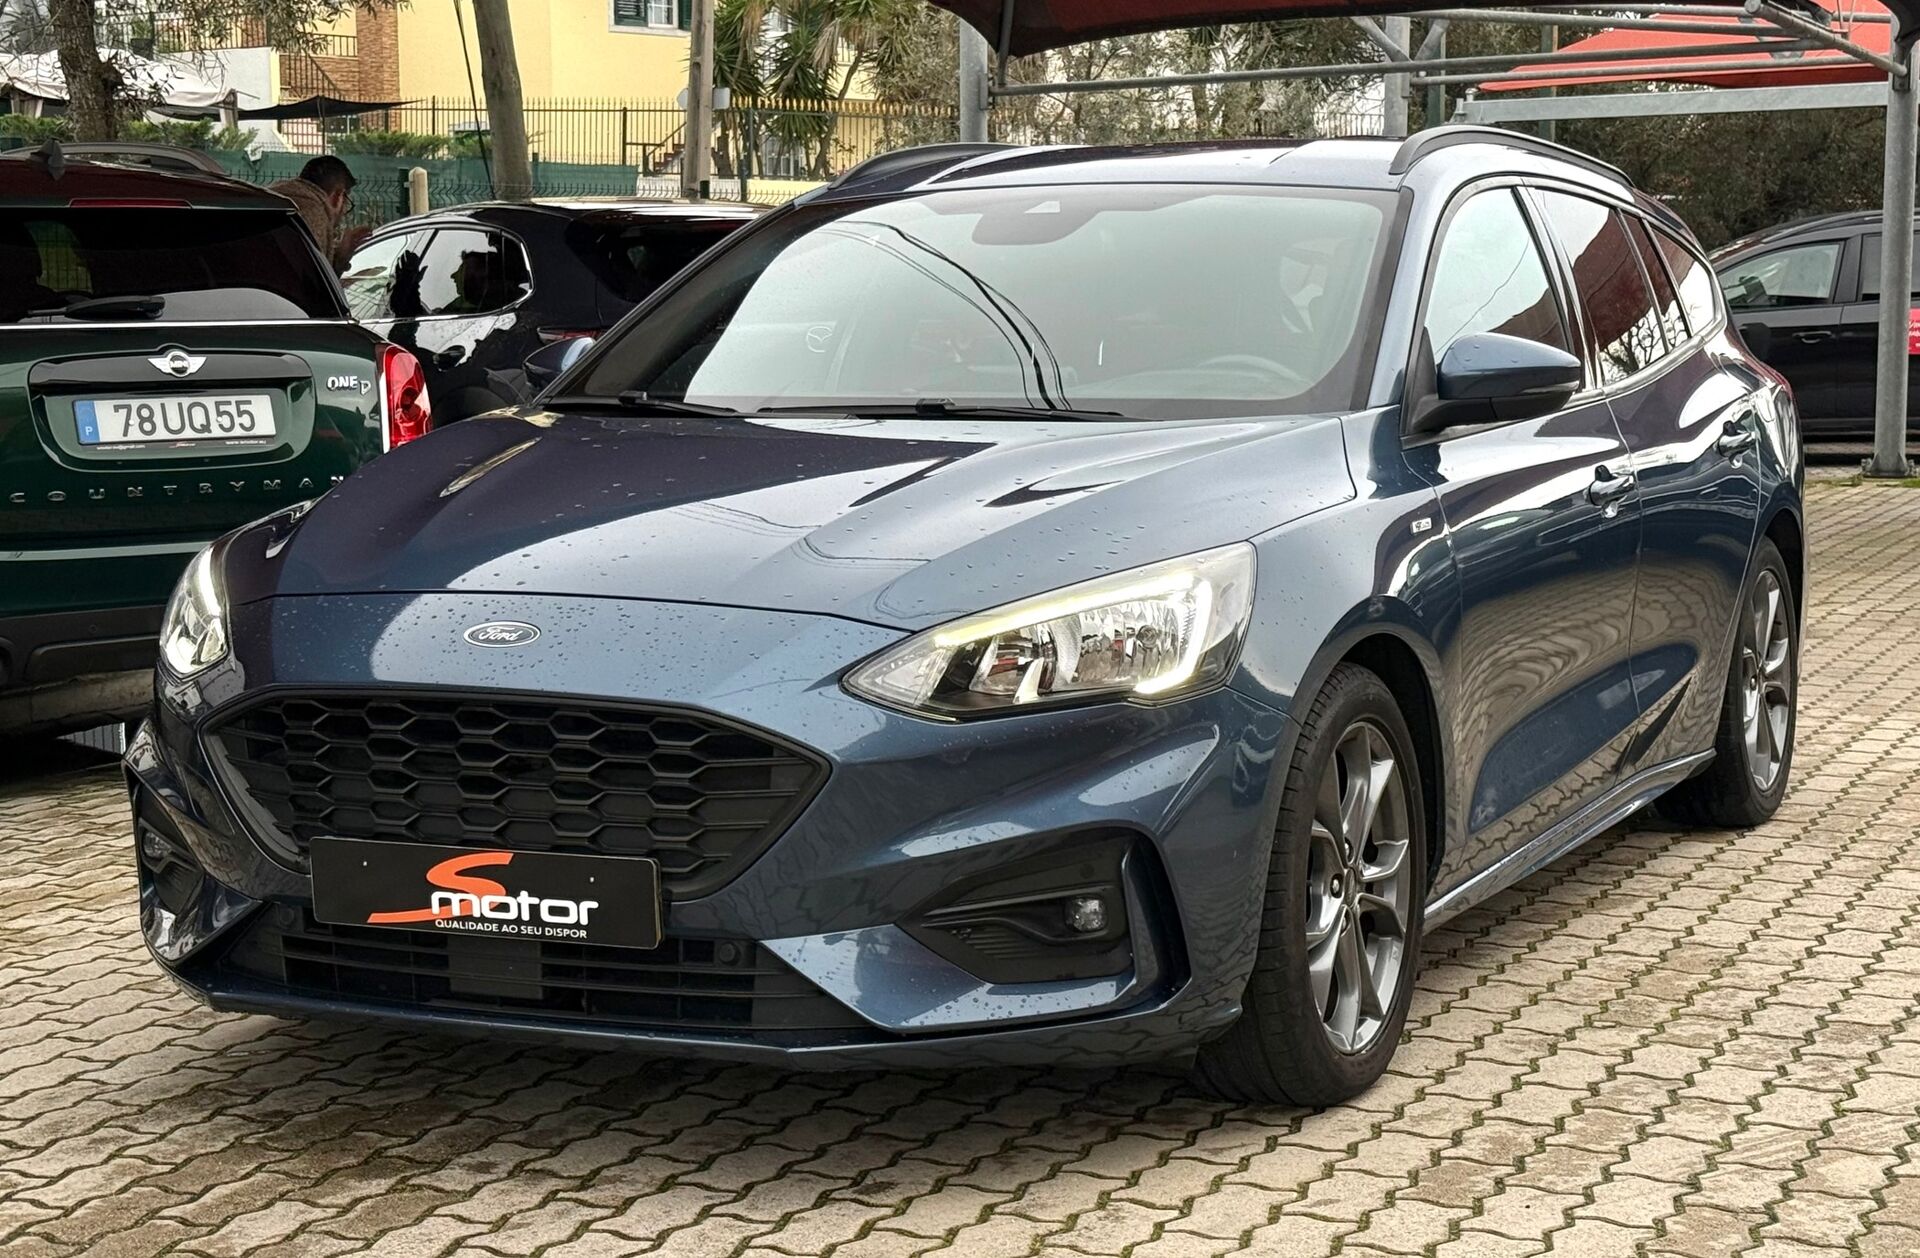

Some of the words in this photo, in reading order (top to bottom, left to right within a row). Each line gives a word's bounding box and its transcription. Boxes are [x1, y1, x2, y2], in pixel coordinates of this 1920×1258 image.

[327, 376, 358, 390] ONE
[113, 400, 256, 437] 78UQ55
[85, 426, 93, 436] P
[479, 626, 523, 641] Ford
[435, 919, 499, 932] QUALIDADE
[501, 924, 518, 933] AO
[520, 925, 542, 936] SEU
[545, 927, 587, 939] DISPOR
